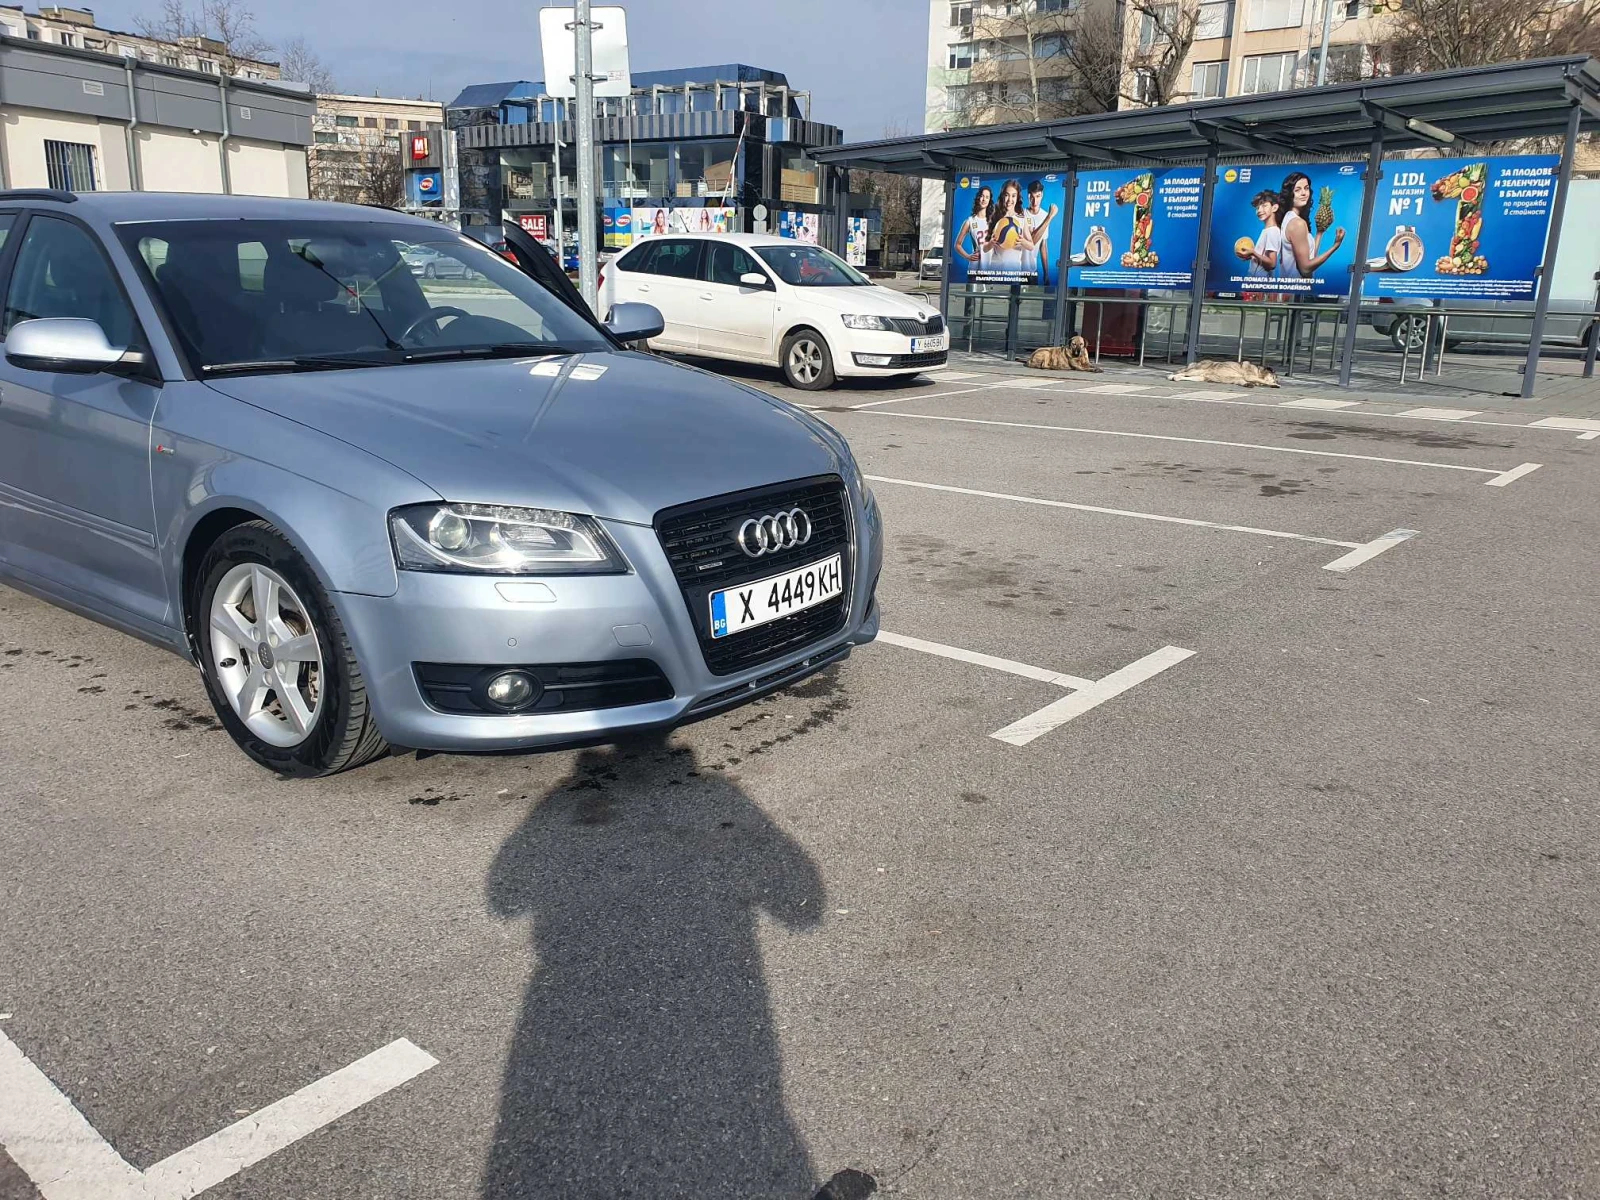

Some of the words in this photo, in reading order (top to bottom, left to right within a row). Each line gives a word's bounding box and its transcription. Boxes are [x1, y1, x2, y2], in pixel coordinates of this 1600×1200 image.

[1512, 168, 1552, 176] ПЛОДОВЕ
[1394, 172, 1426, 186] LIDL
[1502, 178, 1551, 188] ЗЕЛЕНЧУЦИ
[1087, 180, 1110, 192] LIDL
[1415, 198, 1423, 215] 1
[1512, 199, 1547, 207] продажби
[1103, 203, 1110, 217] 1
[522, 218, 544, 230] SALE
[1095, 239, 1101, 258] 1
[1402, 241, 1409, 262] 1
[739, 590, 754, 623] X
[714, 620, 726, 630] BG
